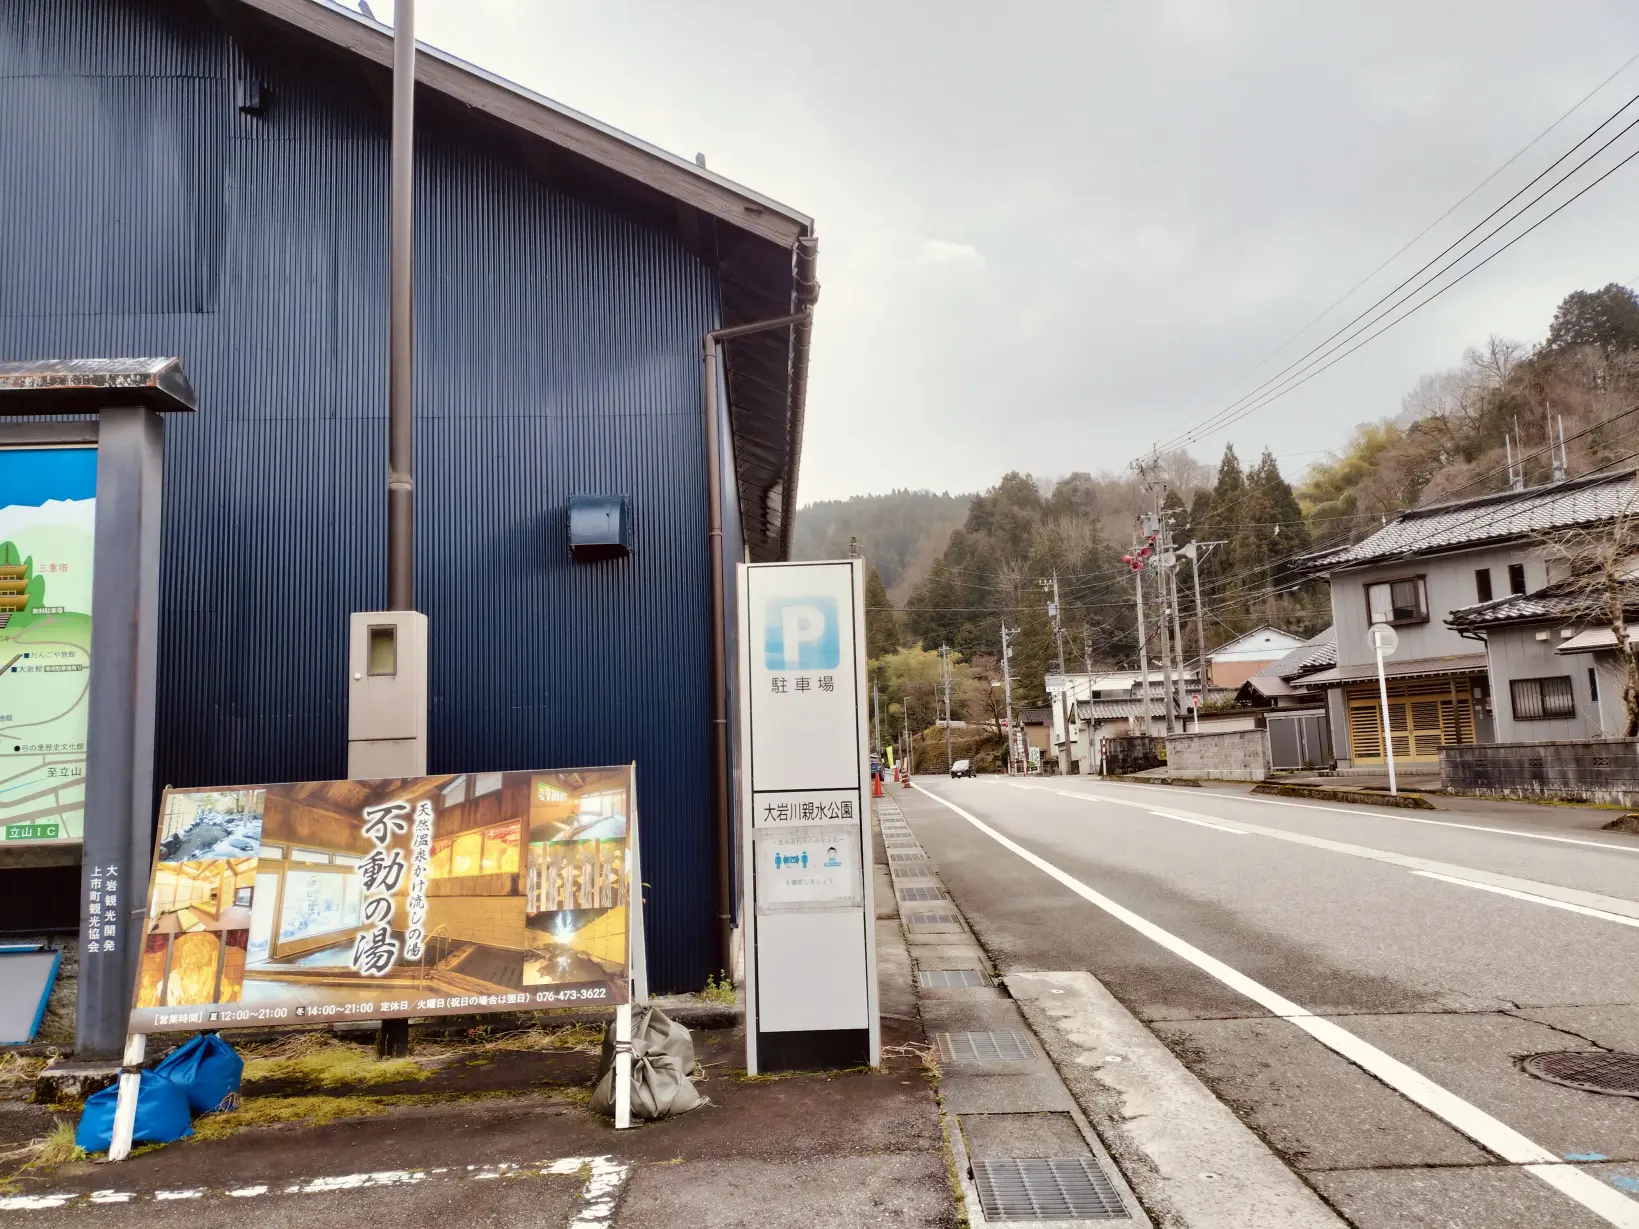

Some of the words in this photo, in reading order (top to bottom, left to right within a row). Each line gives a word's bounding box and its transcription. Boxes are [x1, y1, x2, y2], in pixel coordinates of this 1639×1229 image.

[38, 563, 69, 573] 三重塔
[782, 605, 825, 664] P
[18, 665, 44, 673] 大岩館
[770, 675, 835, 694] 駐車場
[21, 742, 85, 752] 弓の里歴史文化館
[47, 766, 82, 778] 至立山
[763, 800, 854, 822] 大岩川親水公園
[352, 803, 407, 976] 不動の湯
[405, 801, 431, 959] 天然温泉かけ流しの湯
[87, 865, 103, 953] 上市町観光協会
[103, 864, 118, 952] 大岩観光開発
[295, 1006, 305, 1017] 冬
[536, 988, 607, 1002] 076-473-3622
